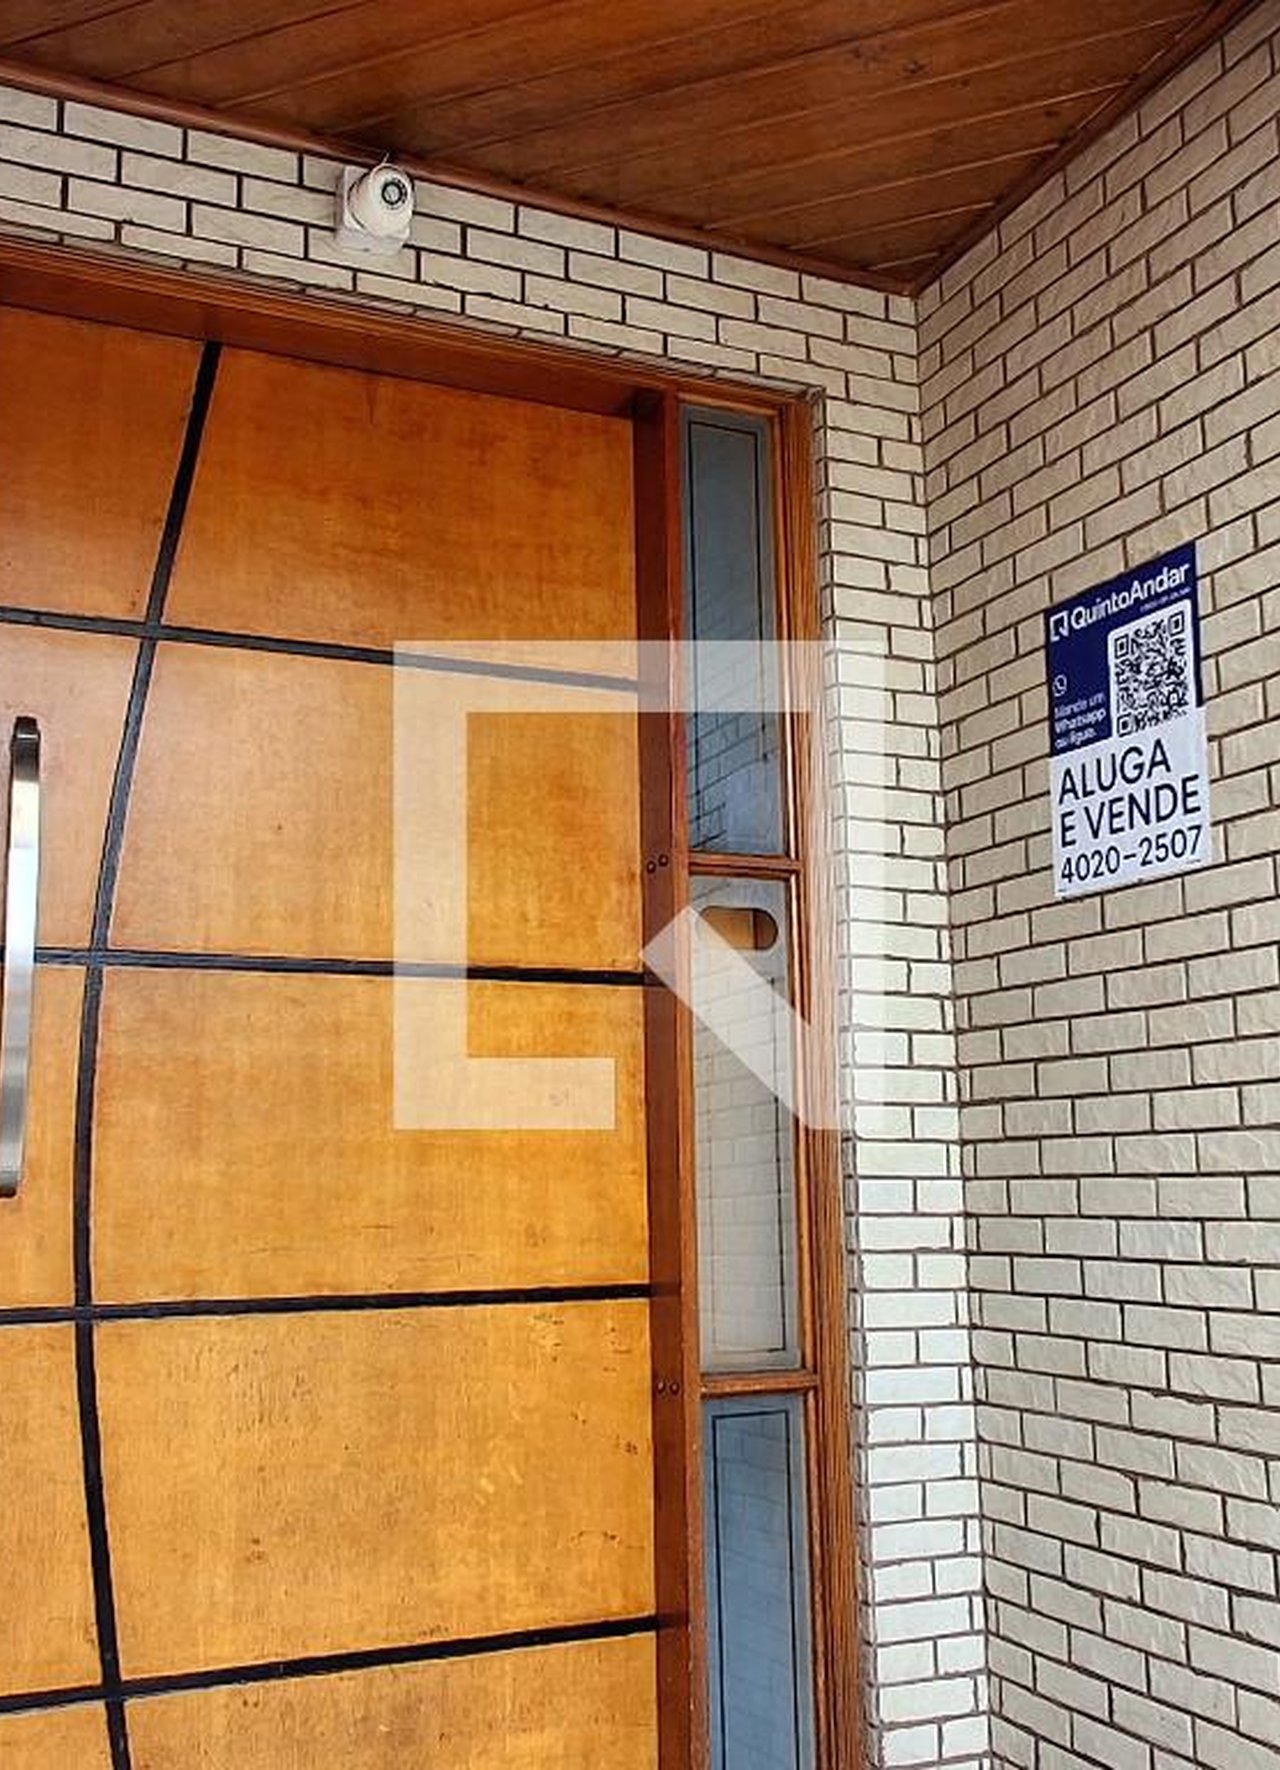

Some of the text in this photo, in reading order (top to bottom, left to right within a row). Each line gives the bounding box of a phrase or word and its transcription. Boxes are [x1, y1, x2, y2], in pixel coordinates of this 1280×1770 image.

[1071, 564, 1190, 629] QuintoAndar
[1059, 738, 1172, 805] ALUGA
[1060, 774, 1202, 848] E VENDE
[1061, 824, 1202, 883] 4020-2507
